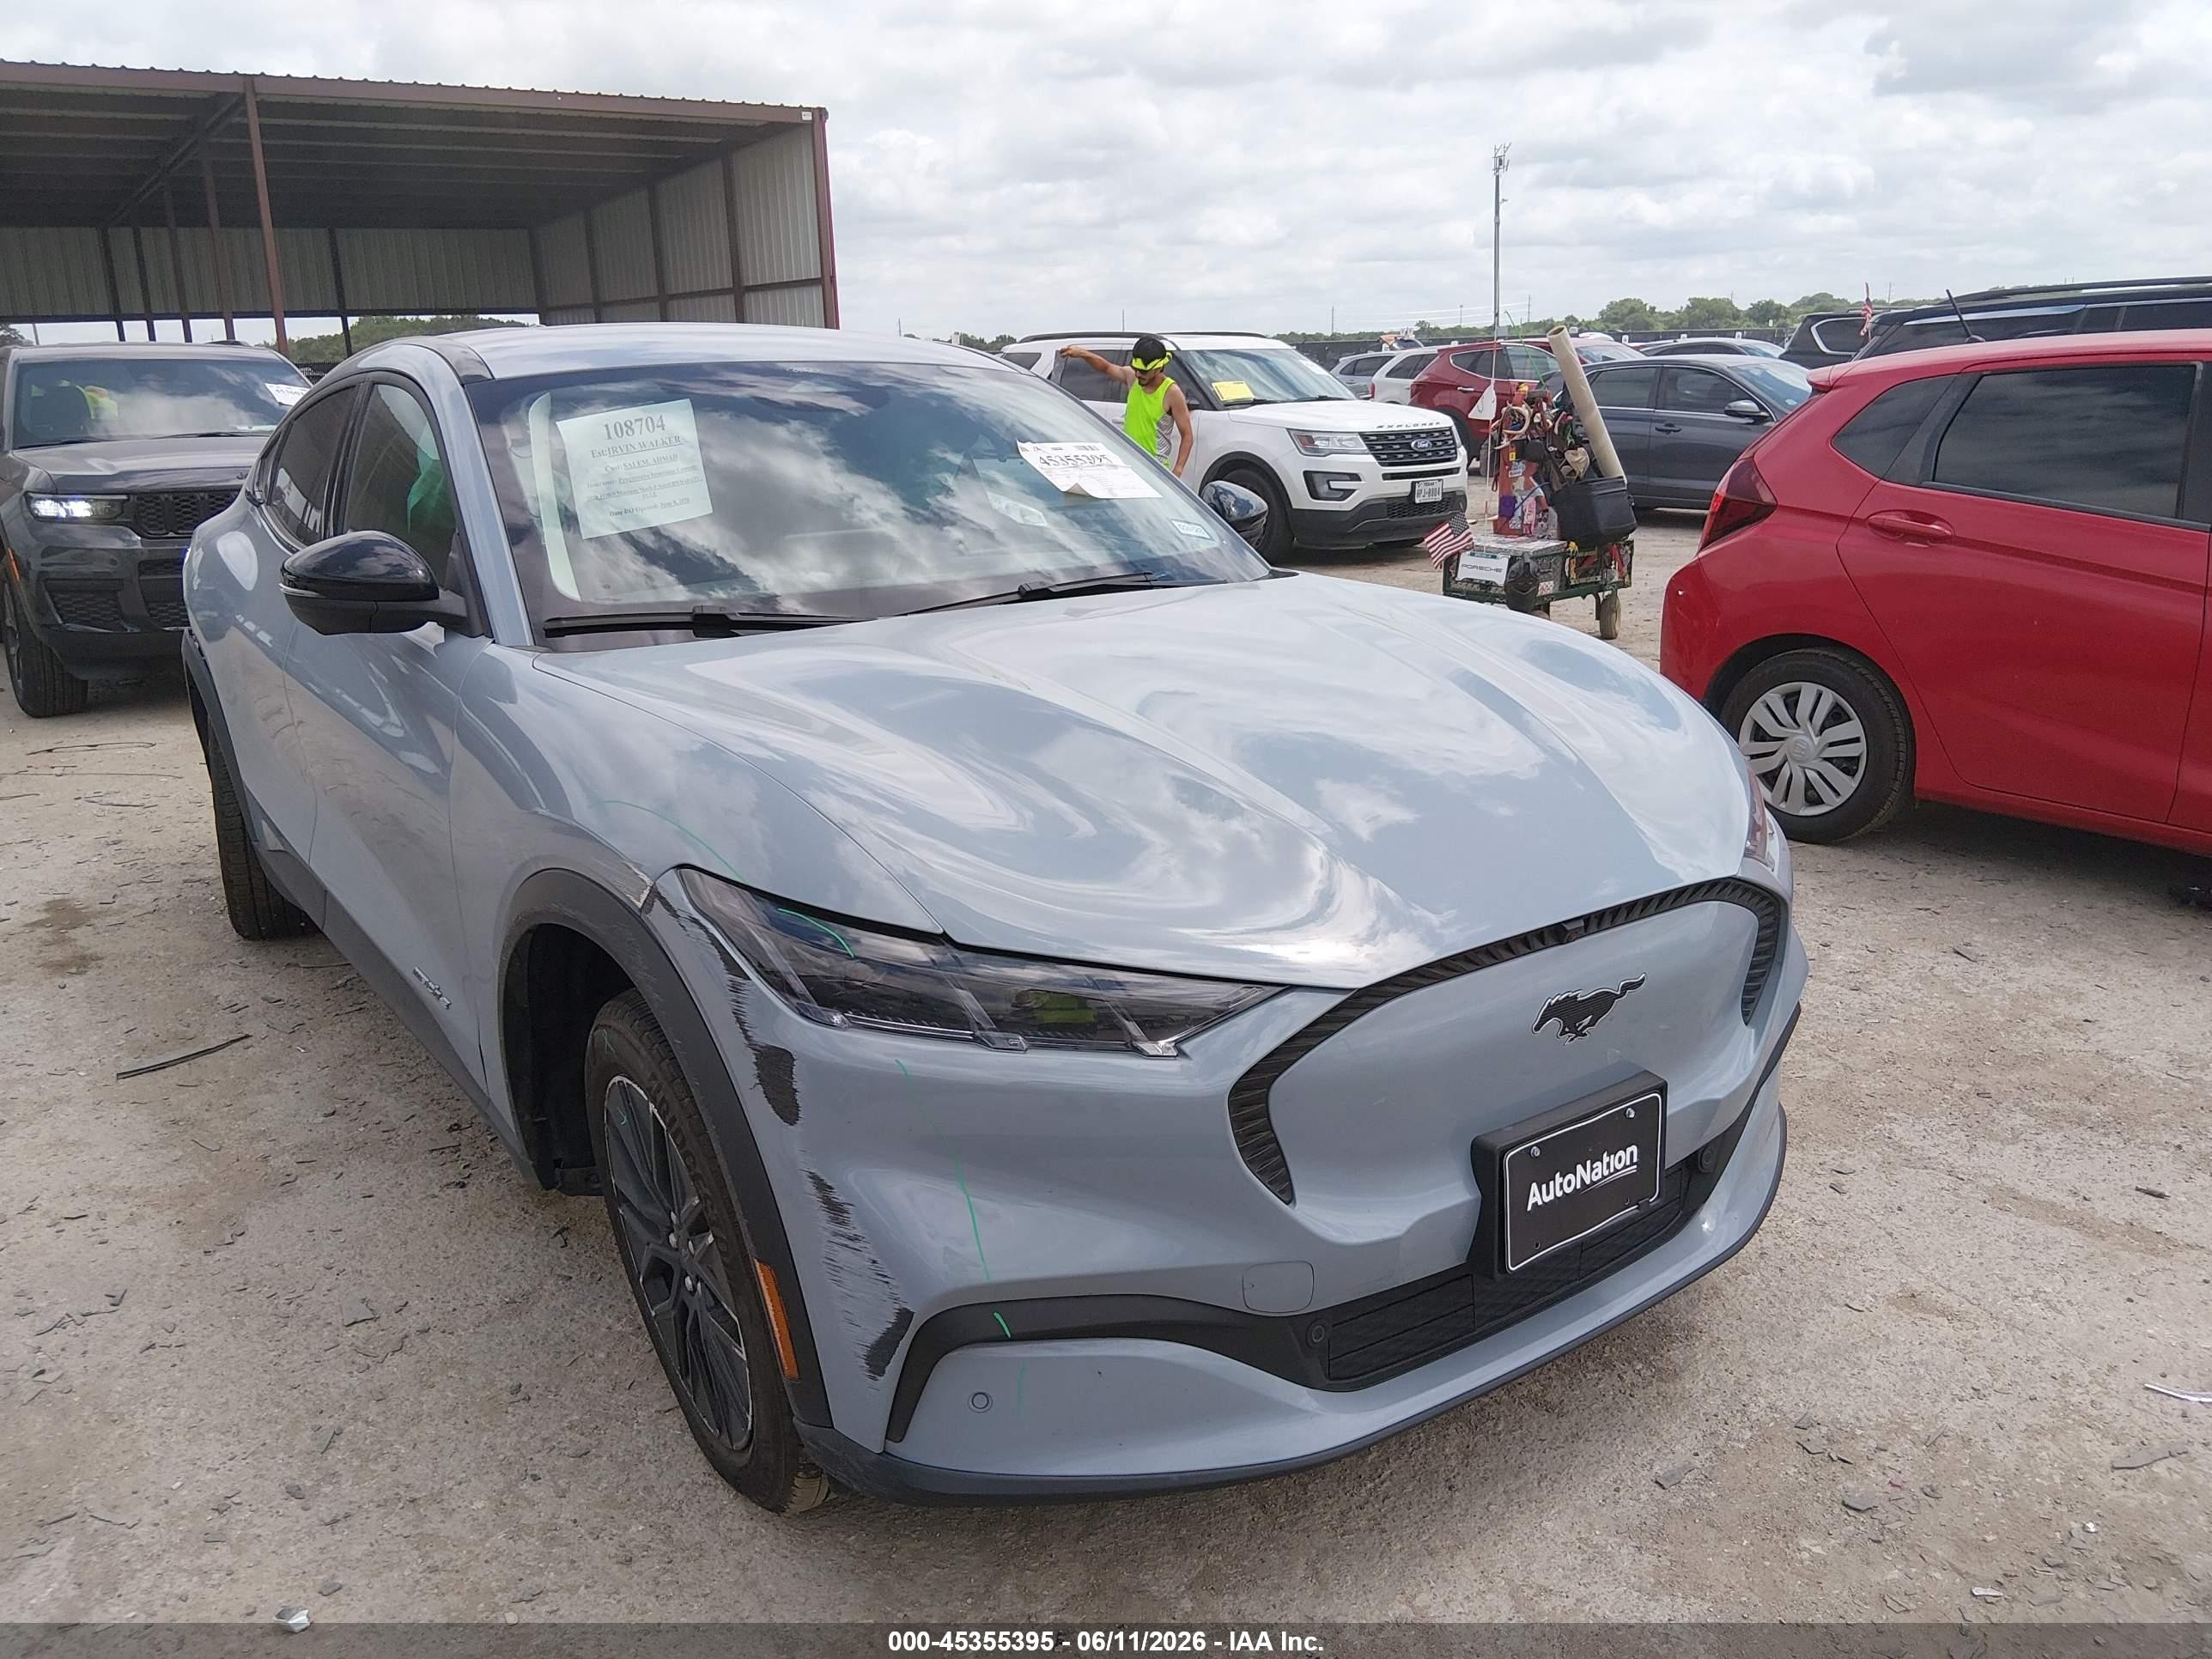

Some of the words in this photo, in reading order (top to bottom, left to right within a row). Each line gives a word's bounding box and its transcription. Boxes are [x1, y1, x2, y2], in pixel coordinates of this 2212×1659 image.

[605, 414, 666, 440] 108704
[638, 434, 682, 450] WALKER
[1461, 563, 1504, 573] PORSCHE
[1527, 1144, 1638, 1212] AutoNation
